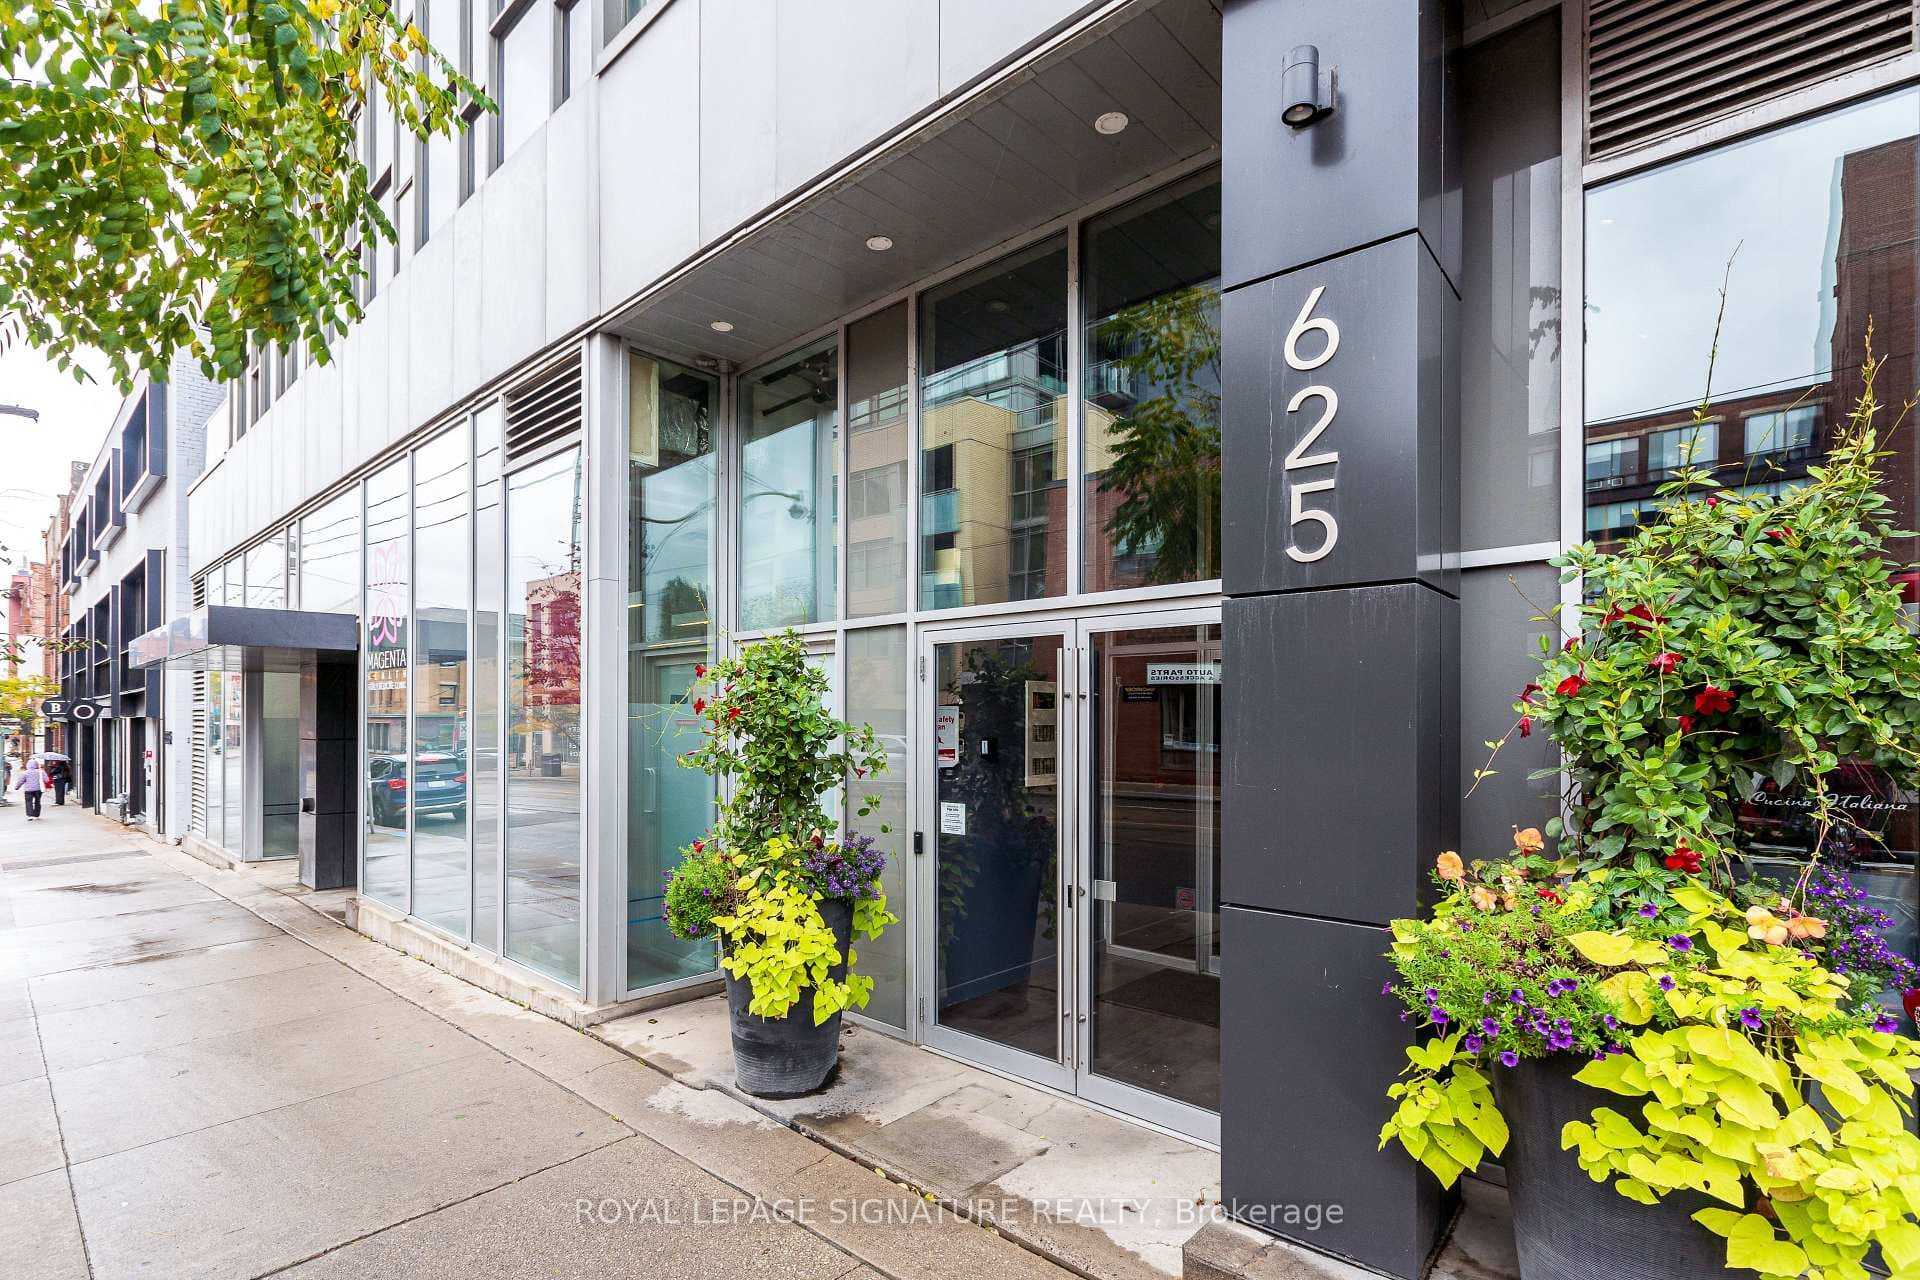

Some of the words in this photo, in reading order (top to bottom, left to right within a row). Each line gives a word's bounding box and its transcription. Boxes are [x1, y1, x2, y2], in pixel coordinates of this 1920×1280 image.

[1284, 285, 1340, 562] 625
[367, 648, 407, 670] MAGENTA
[938, 716, 954, 724] afety
